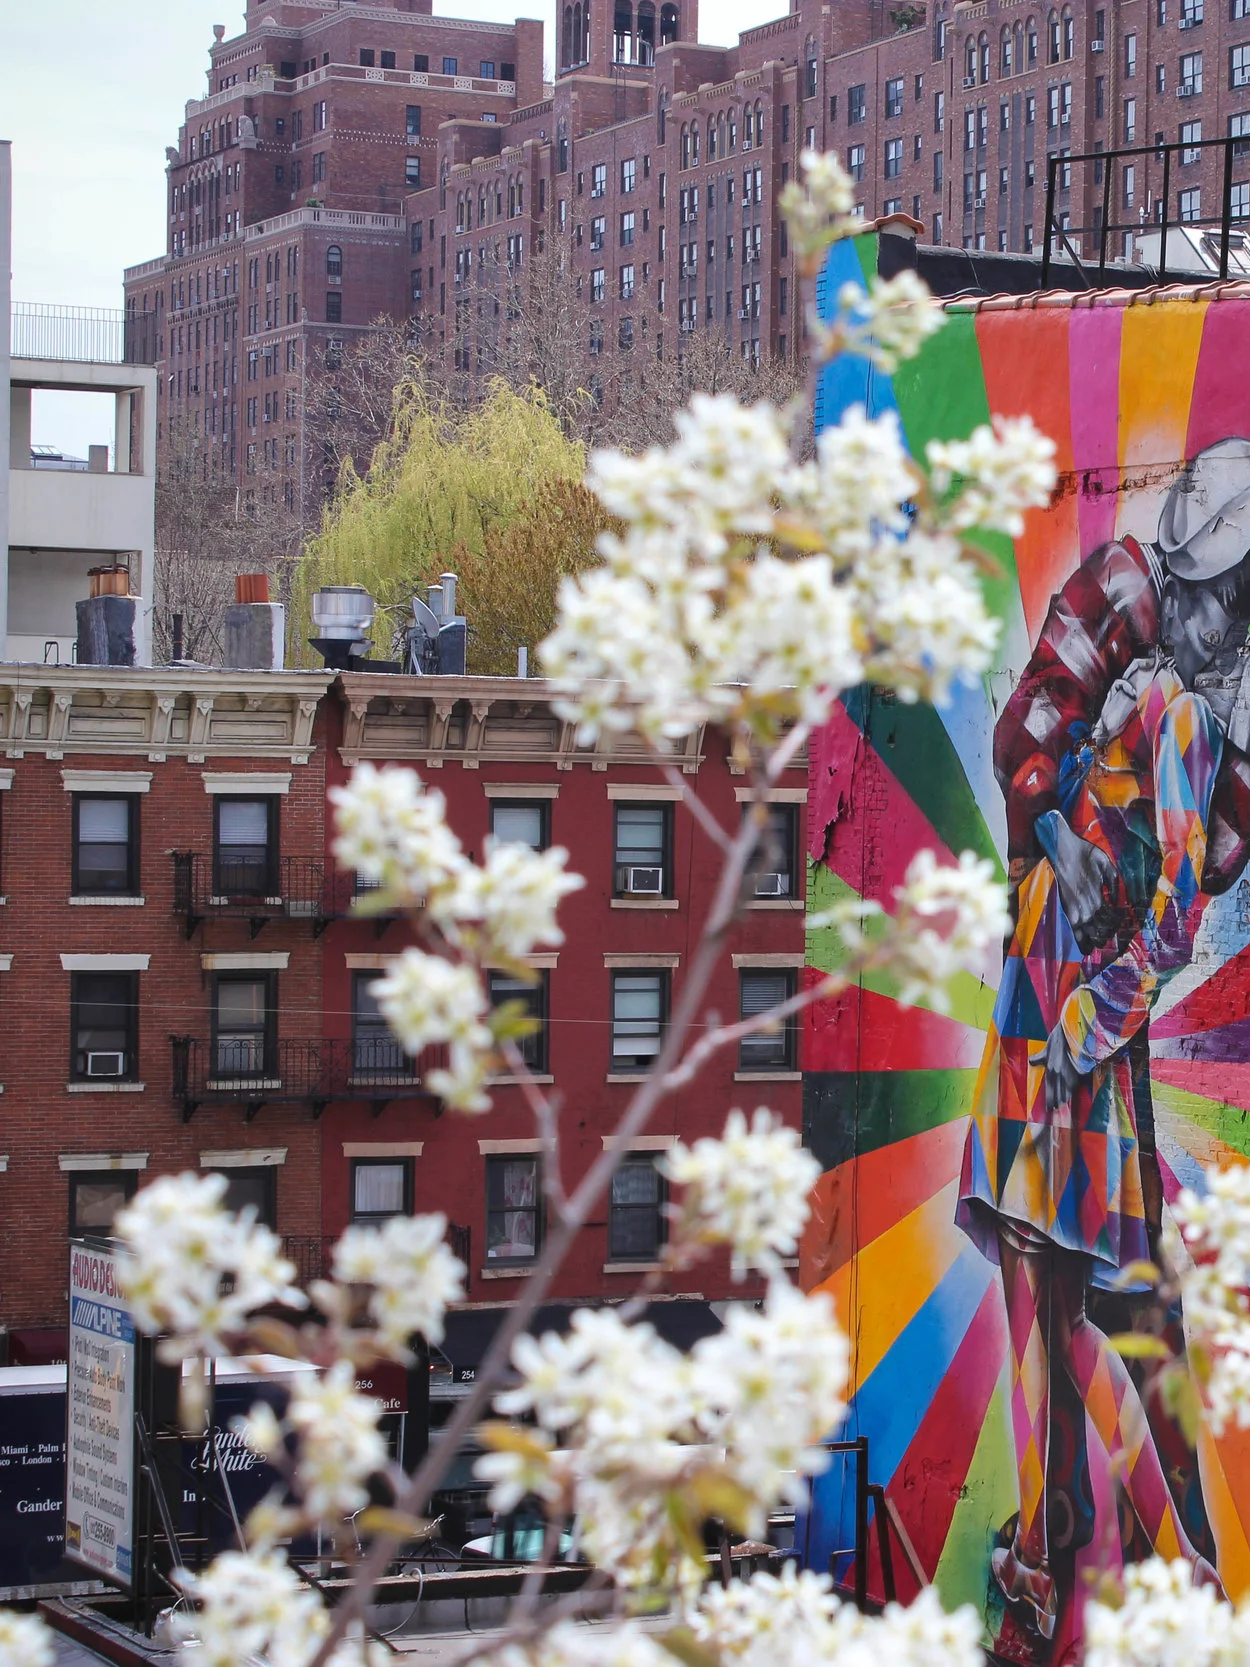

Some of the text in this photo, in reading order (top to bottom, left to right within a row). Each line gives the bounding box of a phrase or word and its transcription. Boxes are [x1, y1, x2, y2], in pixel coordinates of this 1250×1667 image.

[73, 1252, 98, 1292] AUDIO
[461, 1370, 475, 1380] 254
[355, 1380, 373, 1389] 256
[374, 1398, 401, 1409] Cafe
[1, 1445, 28, 1454] Miami
[38, 1443, 59, 1453] Palm
[22, 1455, 52, 1465] London
[17, 1499, 63, 1513] Gander
